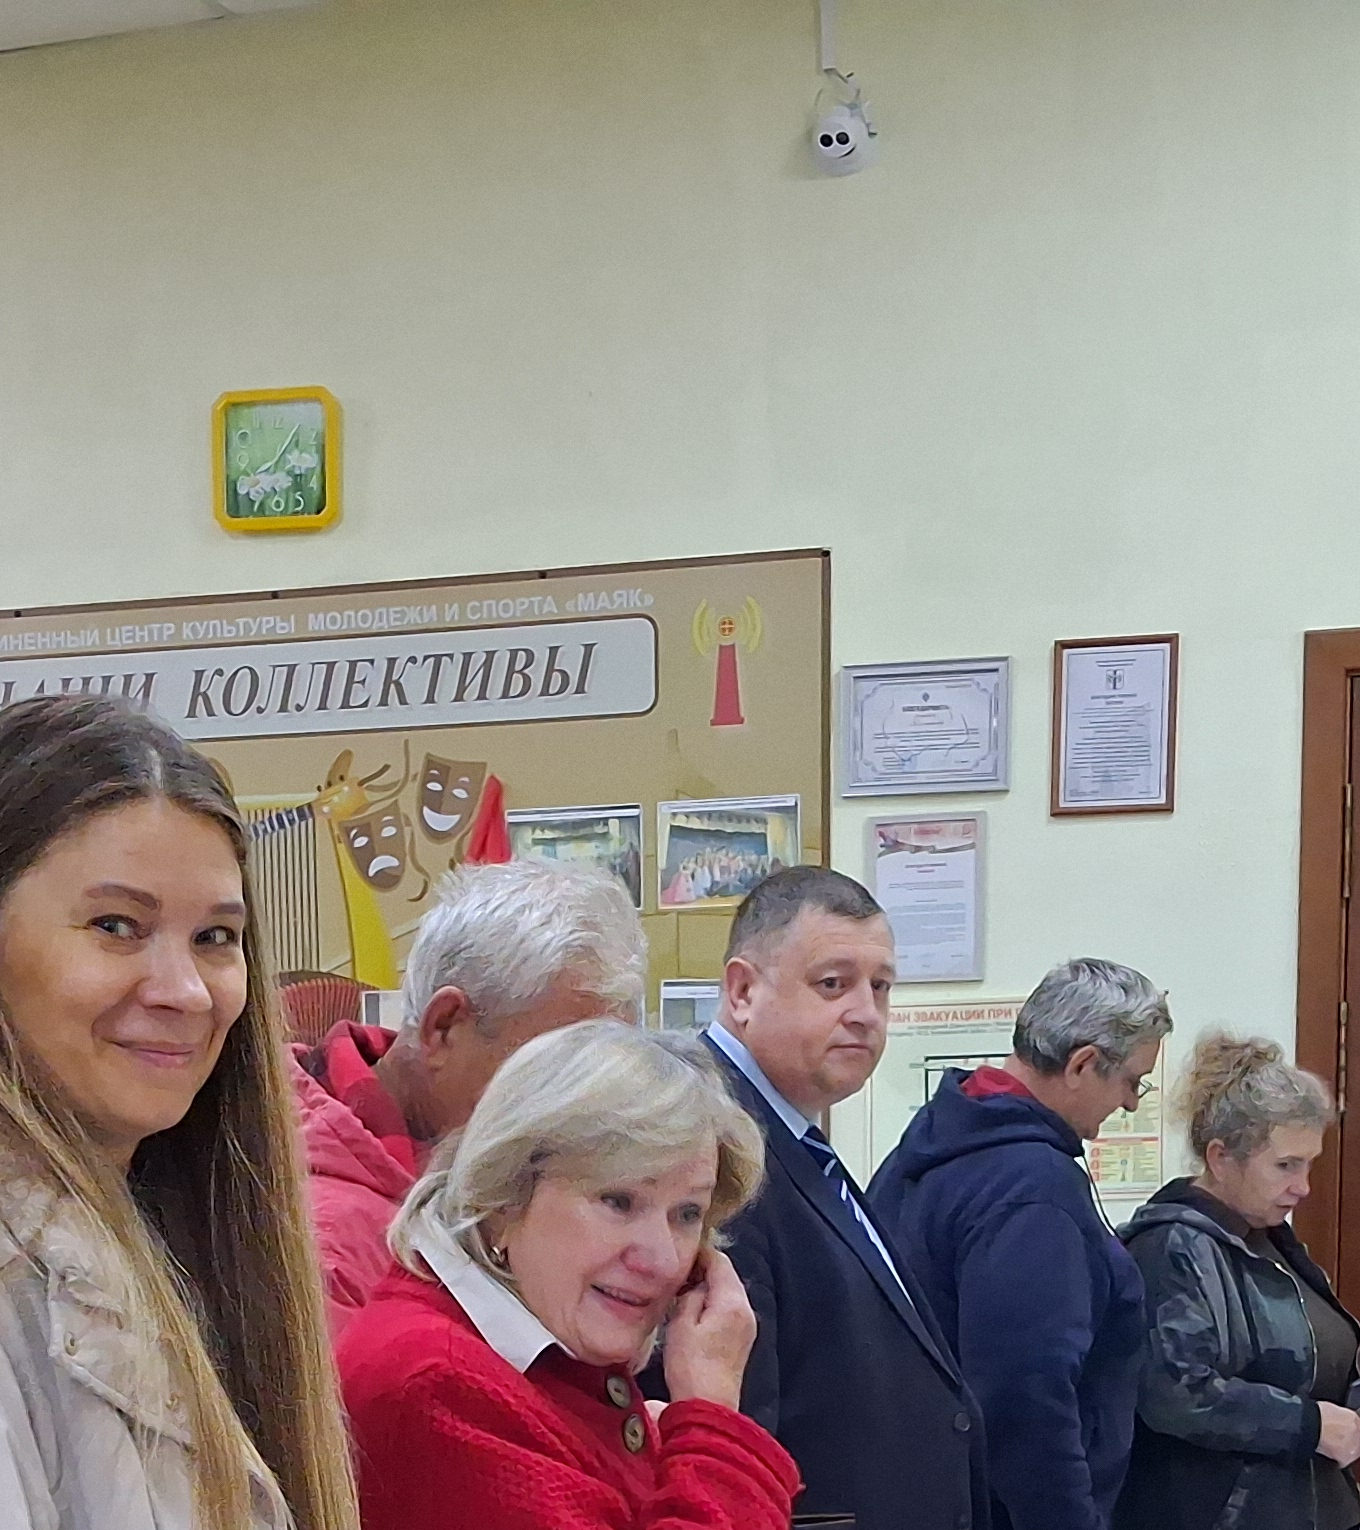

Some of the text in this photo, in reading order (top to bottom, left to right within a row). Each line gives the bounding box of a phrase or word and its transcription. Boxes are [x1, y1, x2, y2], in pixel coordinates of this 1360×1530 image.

[106, 622, 175, 647] ЦЕНТР
[182, 615, 295, 640] КУЛЬТУРЫ
[308, 604, 437, 632] МОЛОДЕЖИ
[444, 602, 460, 622] И
[467, 596, 557, 621] СПОРТА
[565, 588, 654, 613] «МАЯК»
[185, 642, 598, 720] КОЛЛЕКТИВЫ
[915, 1008, 985, 1023] ЭВАКУАЦИИ
[988, 1006, 1012, 1020] ПРИ
